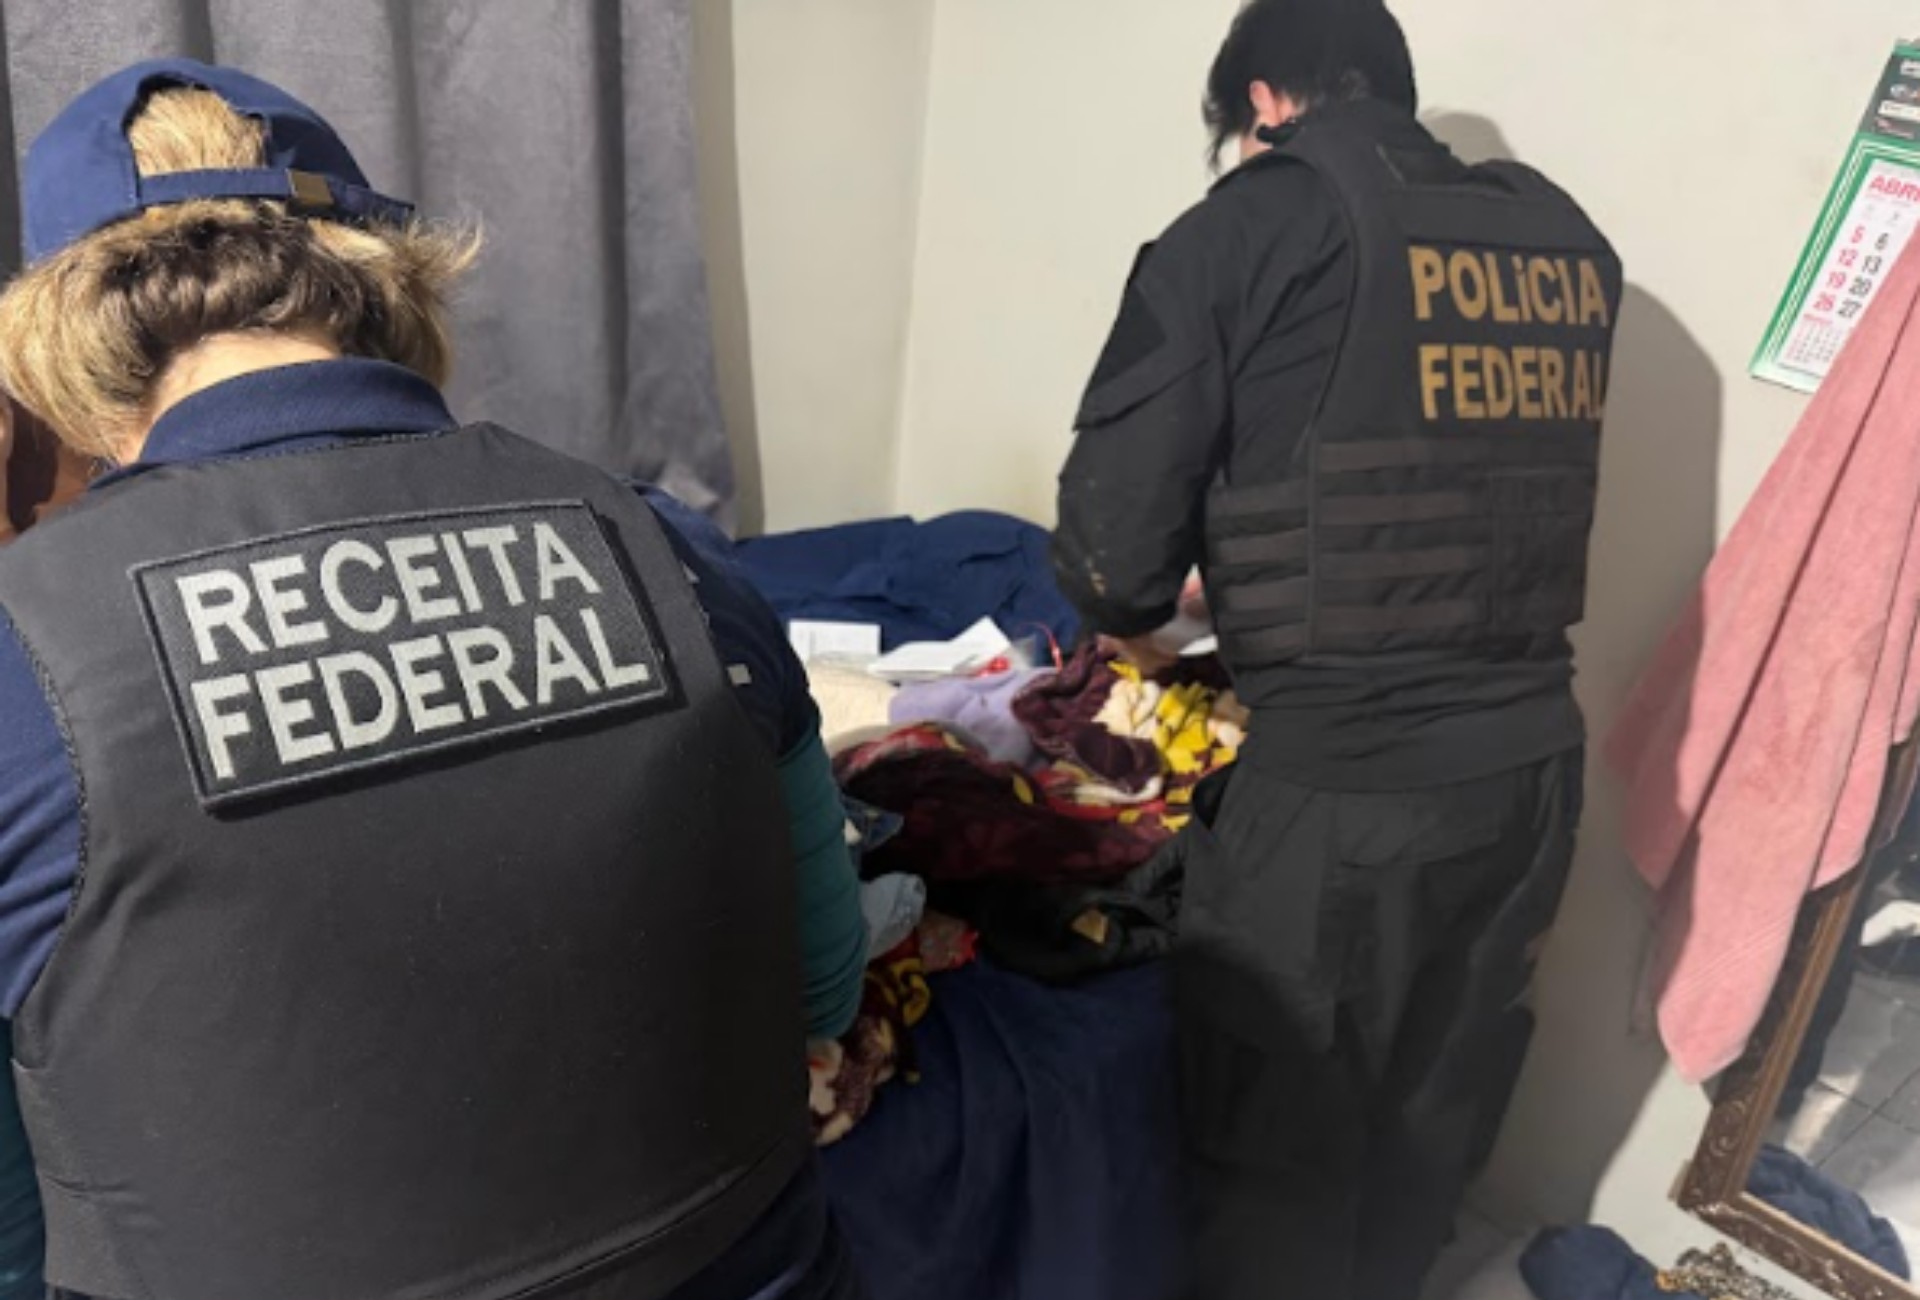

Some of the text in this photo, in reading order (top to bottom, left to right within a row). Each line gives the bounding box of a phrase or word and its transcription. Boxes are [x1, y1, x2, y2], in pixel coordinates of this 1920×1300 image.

[1838, 249, 1882, 273] 12 13
[1851, 225, 1889, 250] 5 6
[177, 523, 600, 665] RECEITA
[190, 607, 648, 778] FEDERAL
